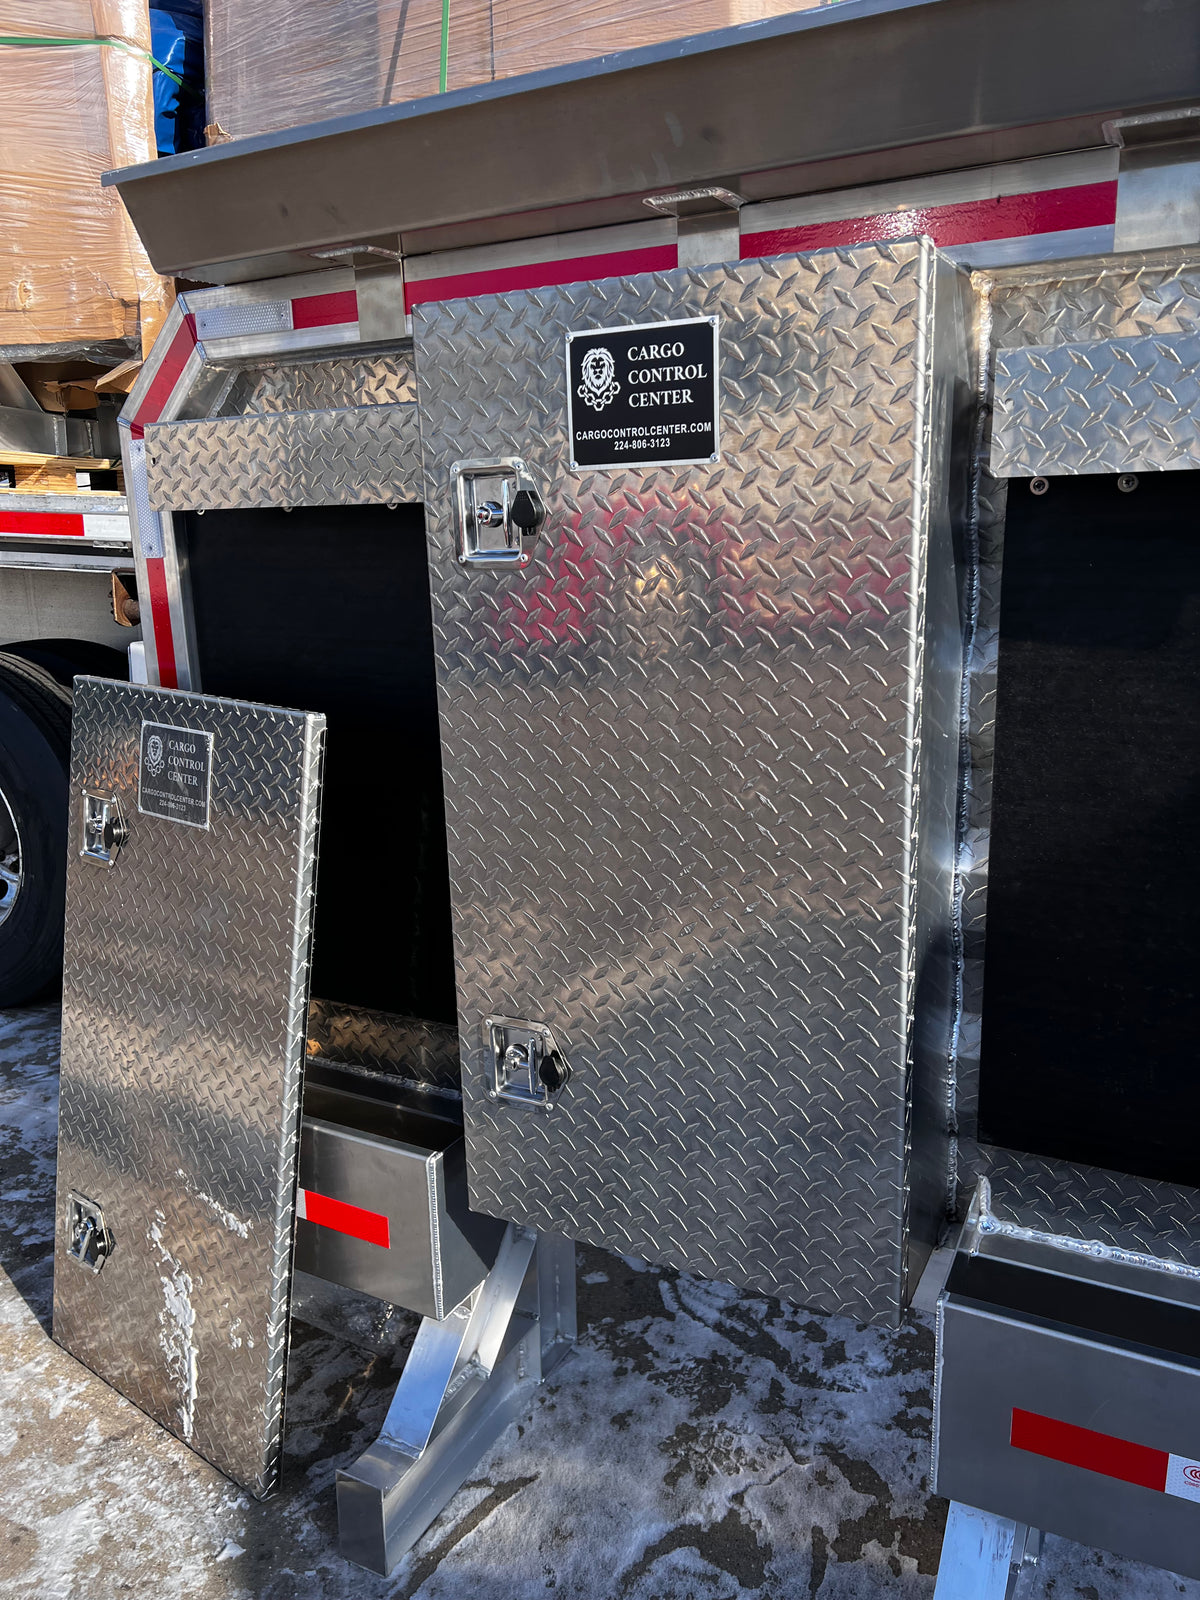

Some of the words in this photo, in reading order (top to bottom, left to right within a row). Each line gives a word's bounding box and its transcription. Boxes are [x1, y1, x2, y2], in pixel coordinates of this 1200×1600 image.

[627, 342, 685, 361] CARGO
[628, 364, 707, 384] CONTROL
[628, 389, 694, 408] CENTER
[576, 422, 712, 441] CARGOCONTROLCENTER.COM
[614, 438, 671, 451] 224-806-3123
[168, 740, 196, 754] CARGO
[168, 755, 206, 772] CONTROL
[167, 770, 198, 786] CENTER
